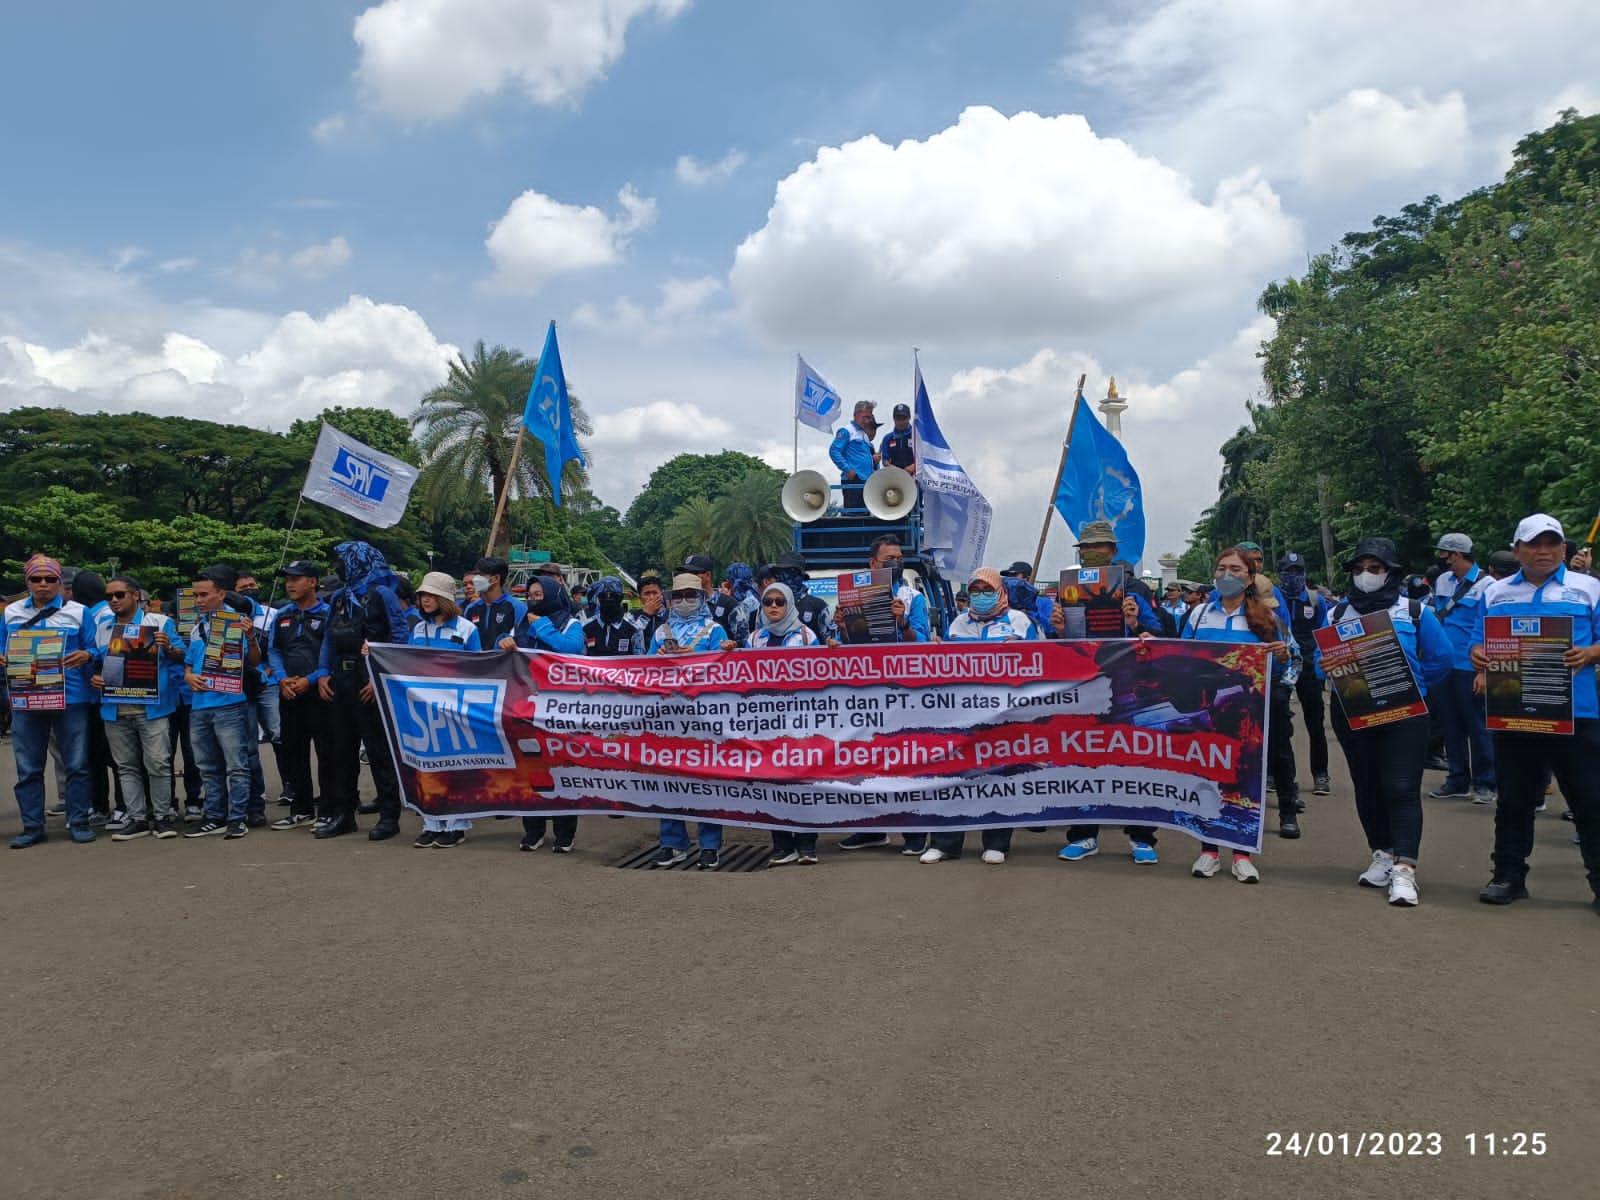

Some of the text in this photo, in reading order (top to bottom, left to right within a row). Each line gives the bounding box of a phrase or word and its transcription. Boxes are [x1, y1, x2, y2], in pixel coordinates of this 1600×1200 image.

[329, 455, 390, 496] SPN
[548, 652, 1043, 687] SERIKAT PEKERJA NASIONAL MENUNTUT..!
[1331, 662, 1360, 678] GNI
[1489, 661, 1519, 673] GNI
[546, 689, 1079, 719] Pertanggungjawaban pemerintah dan PT. GNI atas kondisi
[402, 687, 494, 753] SPN
[545, 712, 884, 735] dan kerusuhan yang terjadi di PT. GNI
[422, 757, 461, 769] PEKERJA
[463, 757, 507, 767] NASIONAL
[546, 730, 1232, 773] POLRI bersikap dan berpihak pada KEADILAN
[560, 776, 1201, 806] BENTUK TIM INVESTIGASI INDEPENDEN MELIBATKAN SERIKAT PEKERJA
